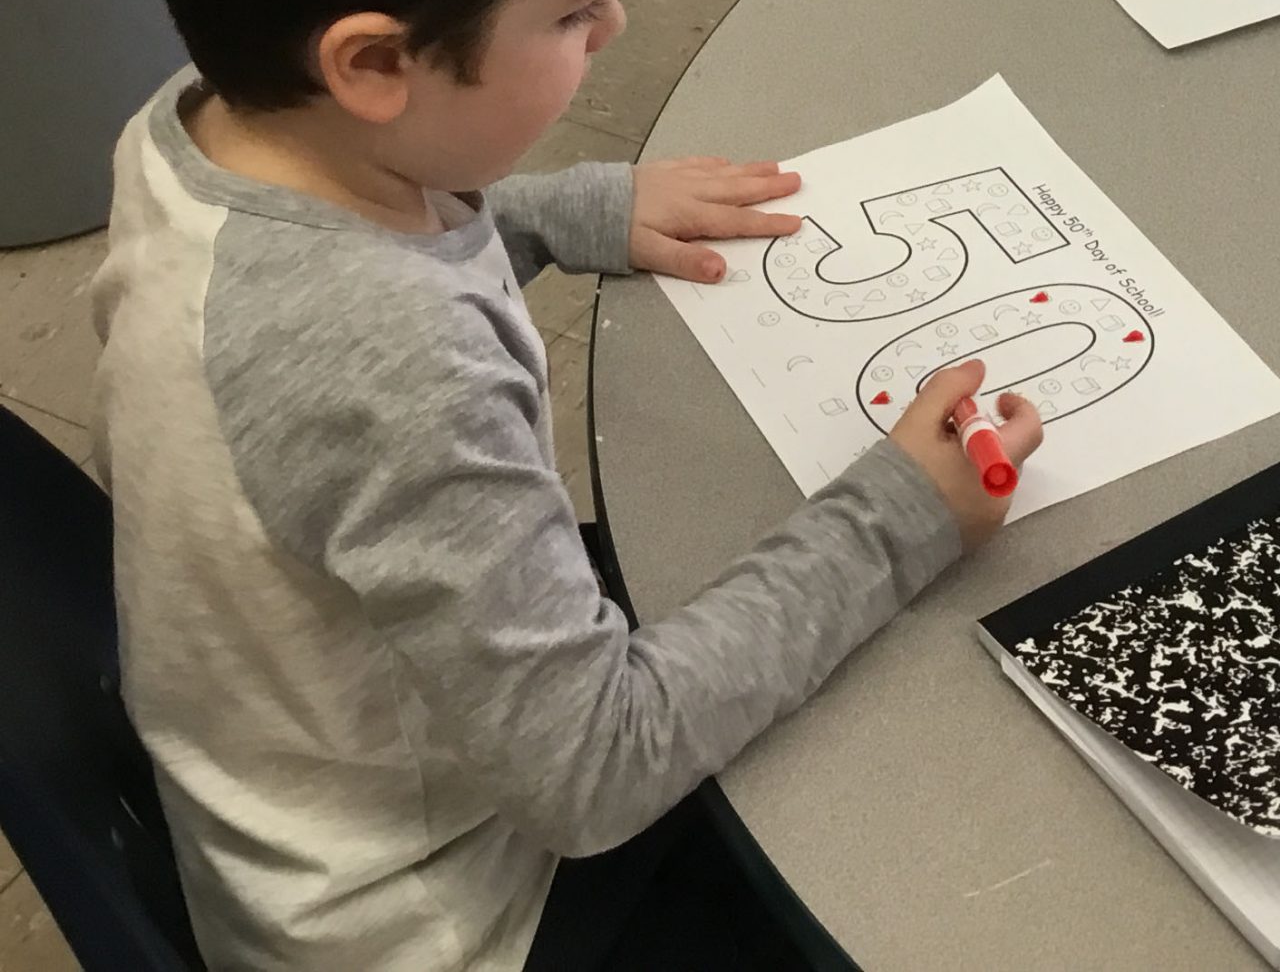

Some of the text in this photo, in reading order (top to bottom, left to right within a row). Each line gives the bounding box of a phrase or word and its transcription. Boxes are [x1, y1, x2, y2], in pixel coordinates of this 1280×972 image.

[1032, 183, 1166, 319] Happy 50th Day of School!
